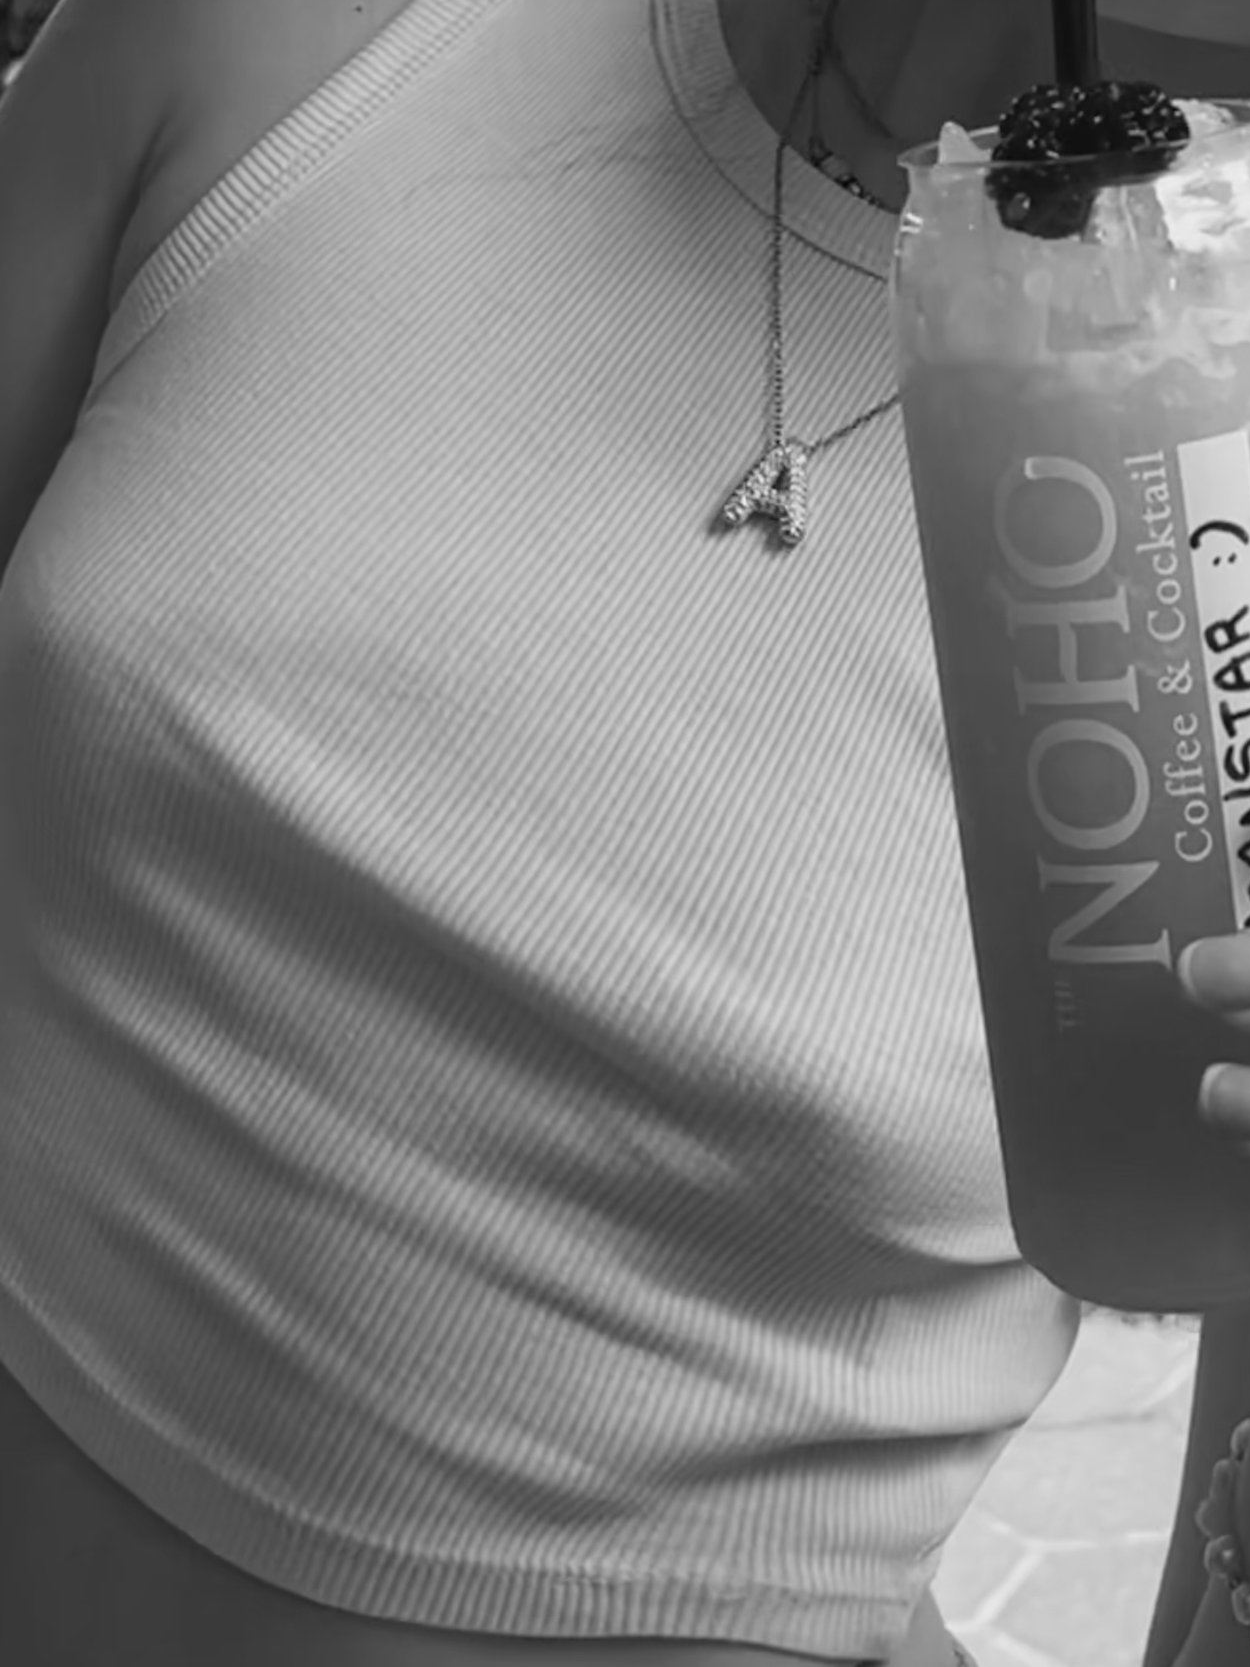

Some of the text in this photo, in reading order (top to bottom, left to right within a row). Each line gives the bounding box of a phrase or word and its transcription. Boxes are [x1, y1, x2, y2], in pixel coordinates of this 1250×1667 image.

[994, 455, 1173, 973] NOHO
[1123, 449, 1213, 863] Coffee & Cocktail
